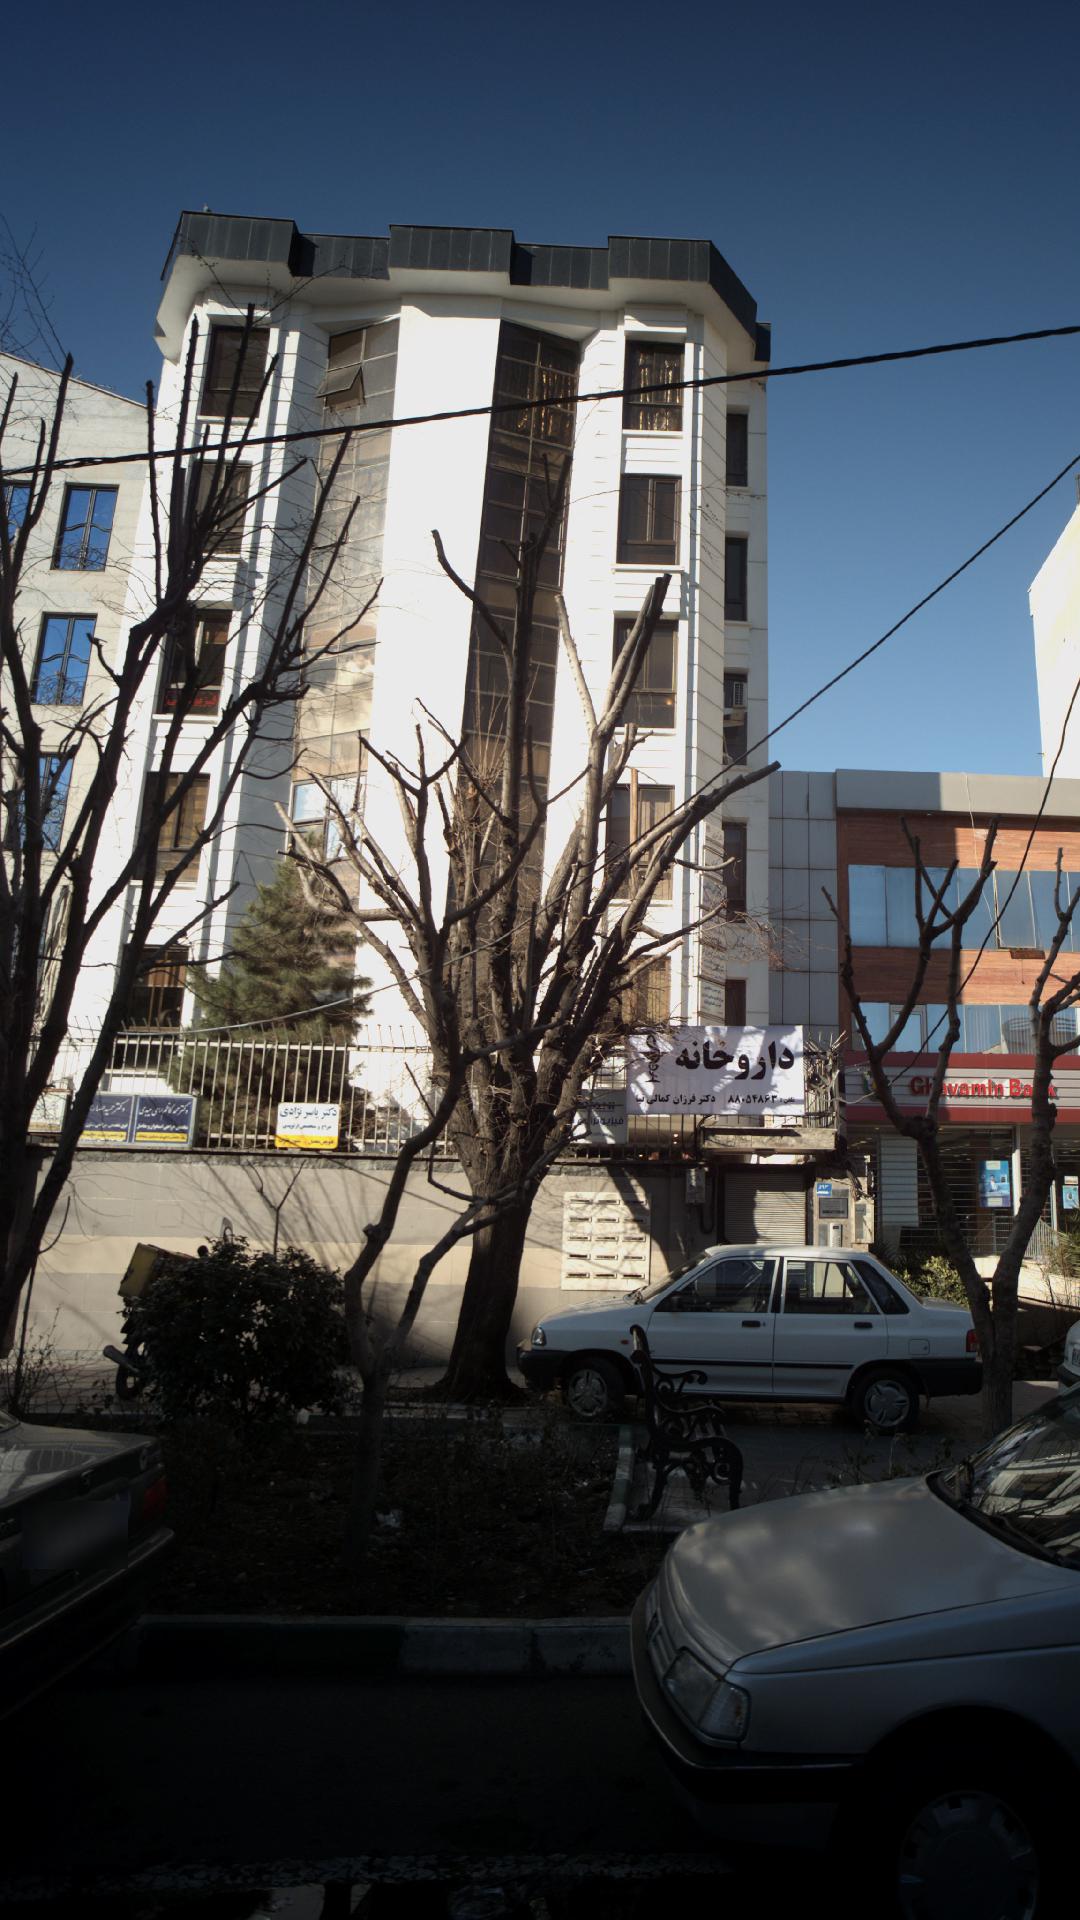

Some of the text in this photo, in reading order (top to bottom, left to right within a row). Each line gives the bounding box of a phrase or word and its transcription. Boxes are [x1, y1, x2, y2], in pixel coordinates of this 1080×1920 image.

[675, 1040, 795, 1080] داروخانه
[1009, 1079, 1058, 1098] Bak
[674, 1094, 696, 1105] فرزان
[700, 1094, 716, 1105] دکتر
[322, 1107, 338, 1119] دکتر
